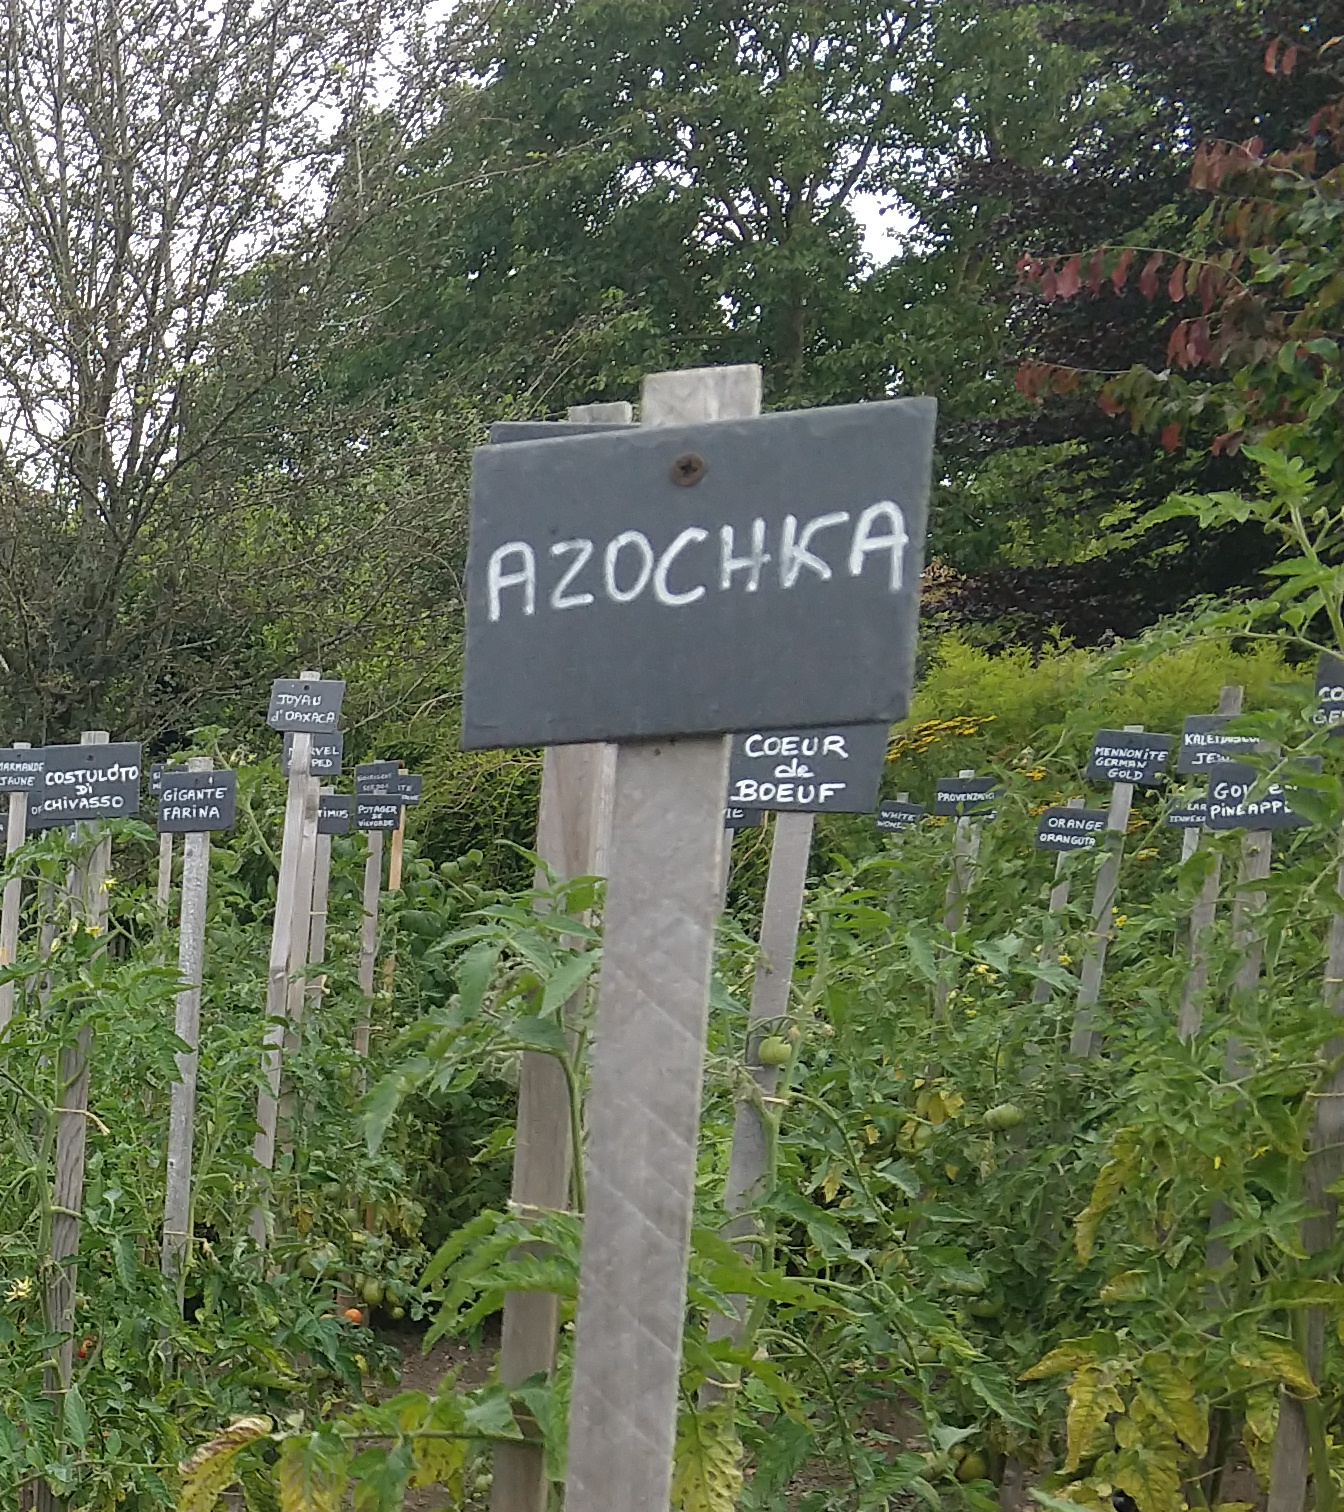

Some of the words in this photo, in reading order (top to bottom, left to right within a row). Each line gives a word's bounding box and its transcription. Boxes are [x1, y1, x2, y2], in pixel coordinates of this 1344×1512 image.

[487, 498, 910, 623] AZOCHKA
[277, 694, 322, 707] JOYAU
[745, 732, 849, 758] COEUR
[774, 757, 815, 778] de
[1107, 768, 1143, 781] GOLD
[729, 779, 846, 804] BOEUF
[1048, 816, 1105, 831] ORANGE
